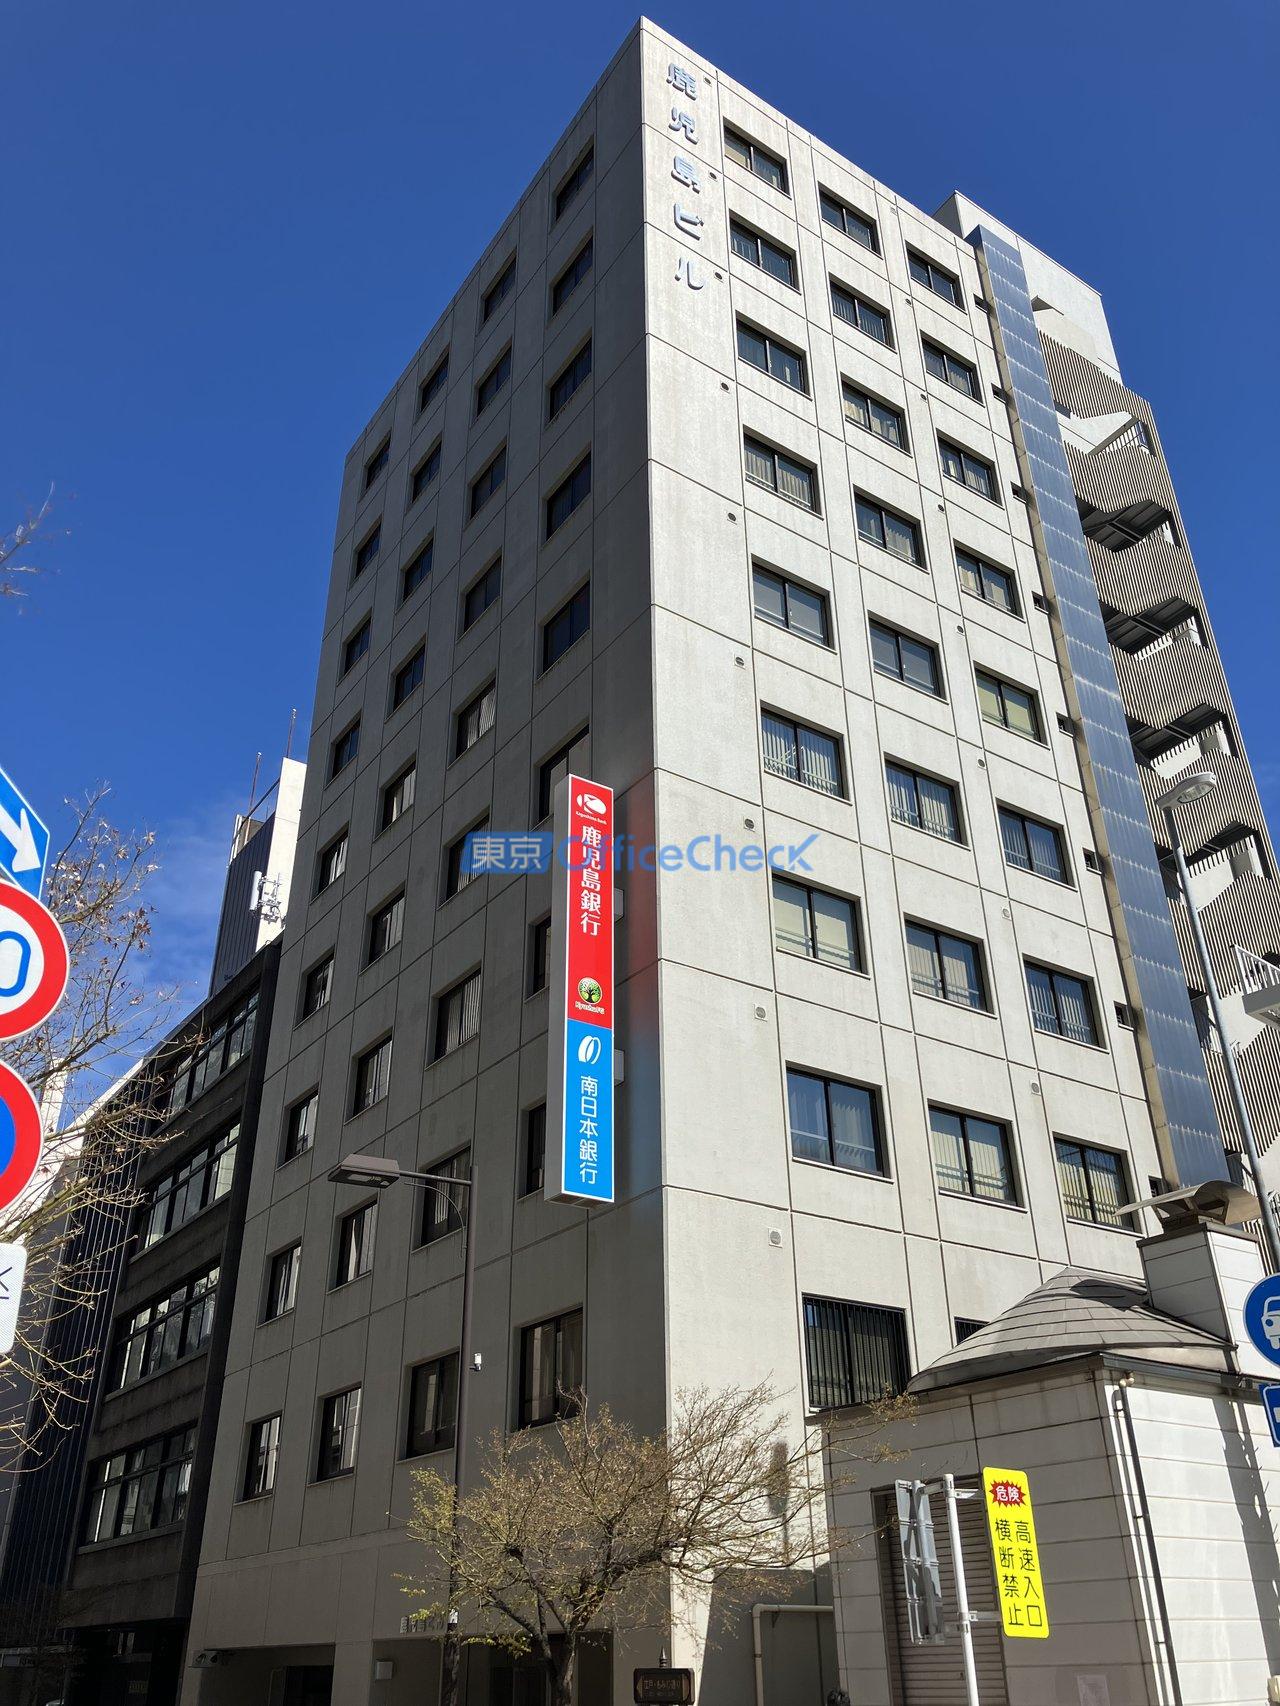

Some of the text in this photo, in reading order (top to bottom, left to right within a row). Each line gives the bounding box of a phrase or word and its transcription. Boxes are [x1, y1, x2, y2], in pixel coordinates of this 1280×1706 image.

[666, 62, 705, 290] 鹿児島ビル
[580, 826, 601, 936] 鹿児島銀行
[579, 1075, 599, 1185] 南日本銀行
[995, 1485, 1021, 1502] 危険
[995, 1517, 1025, 1626] 横断禁止
[1014, 1519, 1043, 1627] 高速入口
